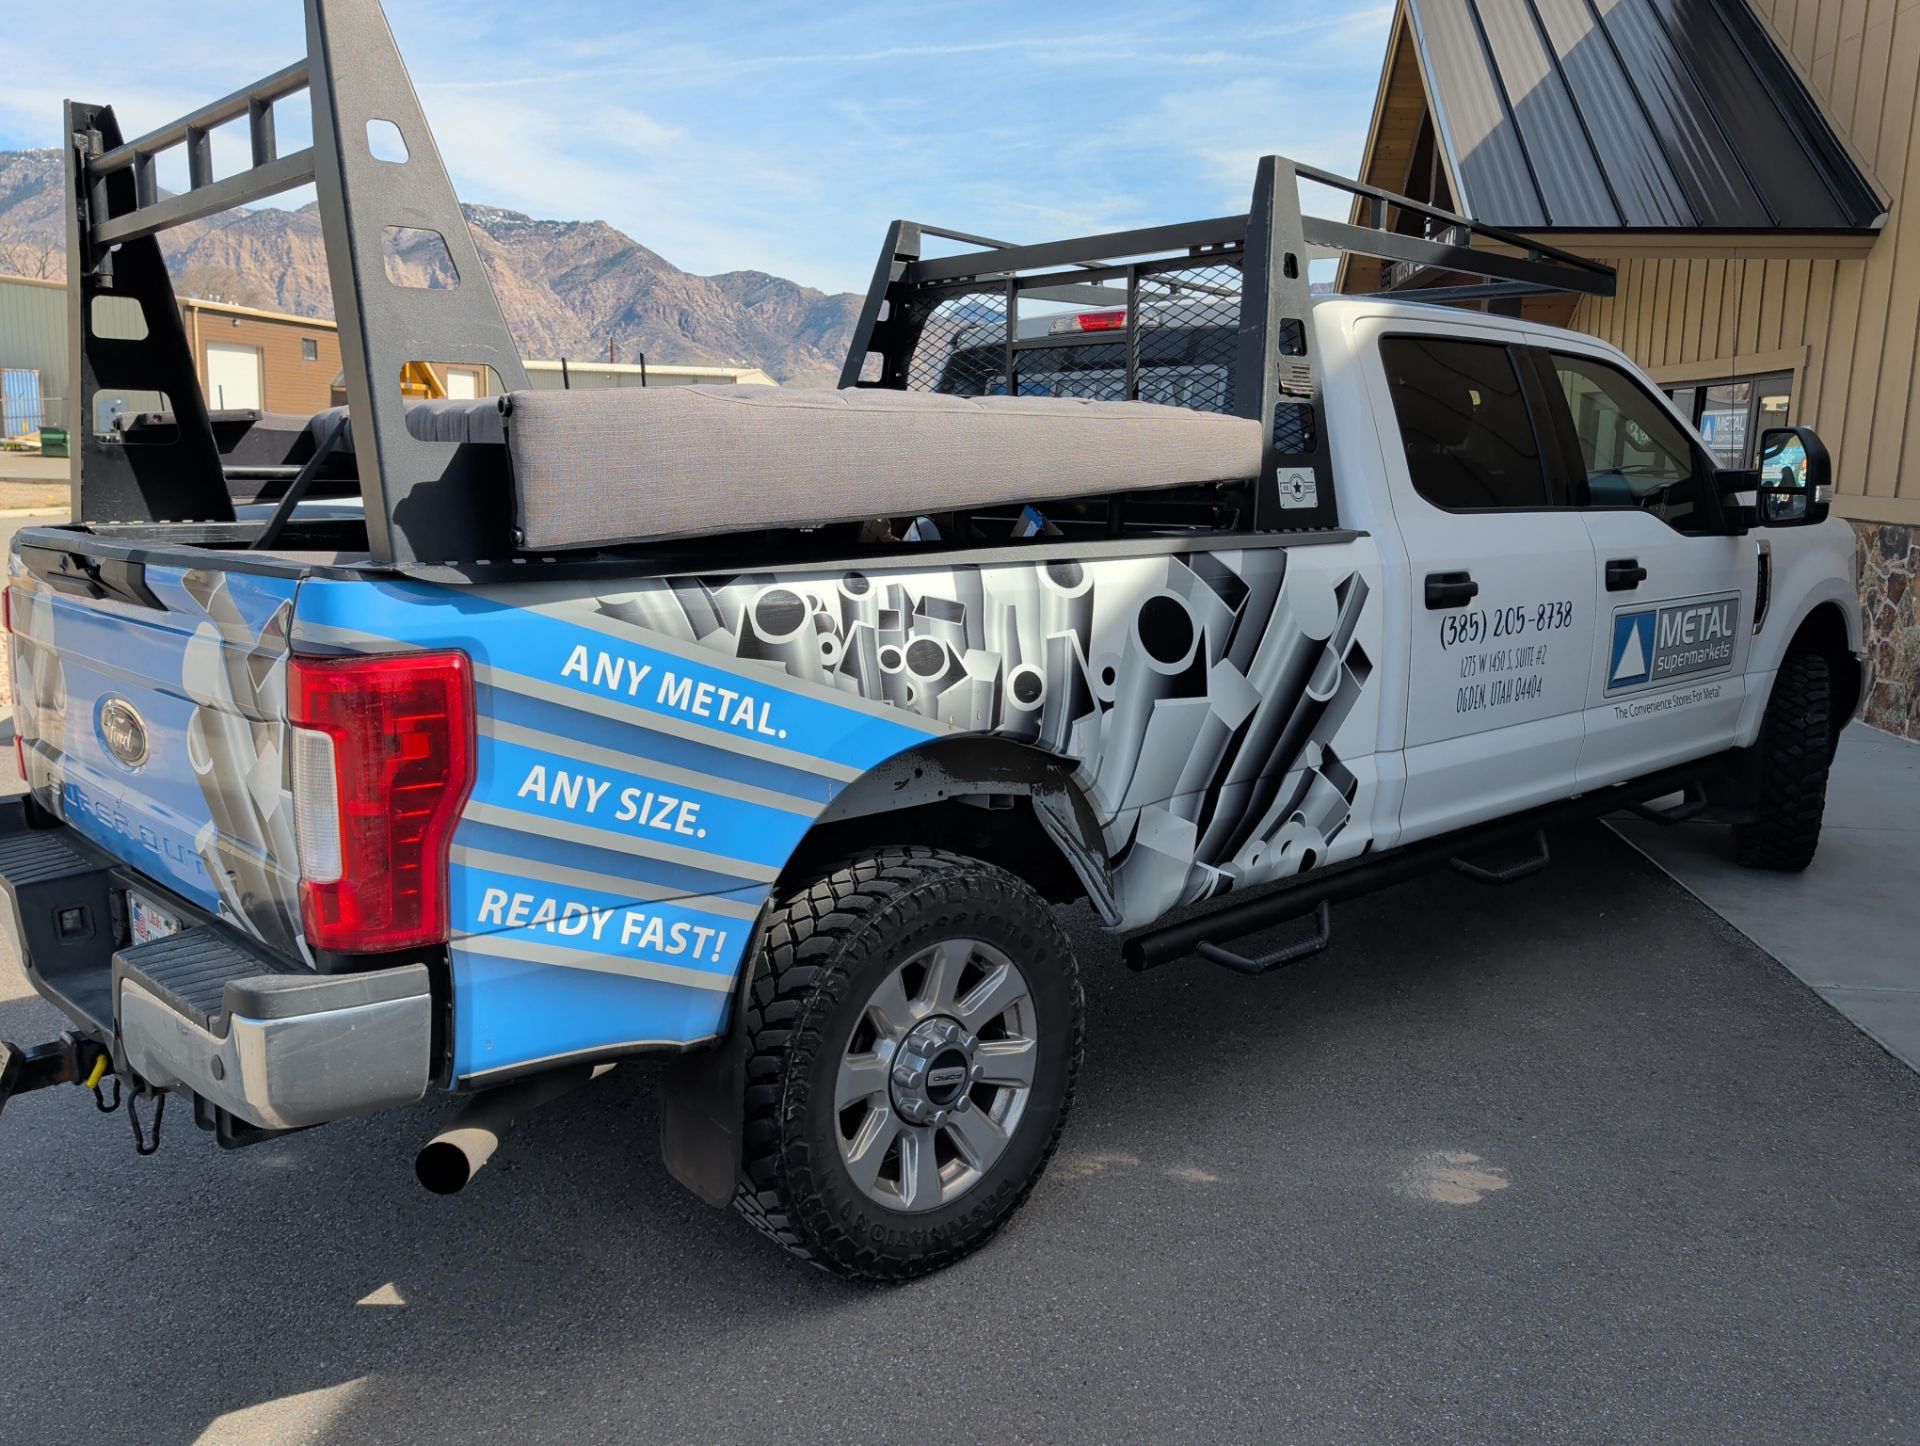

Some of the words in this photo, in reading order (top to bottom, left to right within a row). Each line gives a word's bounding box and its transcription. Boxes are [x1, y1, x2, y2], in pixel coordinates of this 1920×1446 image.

[1440, 609, 1487, 651] (385)
[1493, 601, 1572, 636] 205-8738
[1660, 604, 1732, 649] METAL
[1461, 655, 1476, 678] 1275
[1480, 652, 1487, 672] W
[1489, 650, 1505, 672] 1450
[1515, 647, 1534, 669] SUITE
[1536, 644, 1547, 665] #2
[1657, 641, 1730, 673] supermarkets
[560, 644, 651, 696] ANY
[656, 671, 787, 739] METAL.
[1457, 684, 1487, 713] OGDEN,
[1490, 679, 1514, 706] UTAH
[1515, 675, 1542, 701] 84404
[1614, 707, 1628, 720] The
[1629, 699, 1672, 717] Convenience
[1673, 694, 1692, 708] Stores
[1693, 690, 1703, 702] For
[102, 706, 134, 753] Ford
[517, 764, 612, 814] ANY
[615, 788, 707, 838] SIZE.
[477, 887, 615, 940] READY
[620, 911, 727, 963] FAST!
